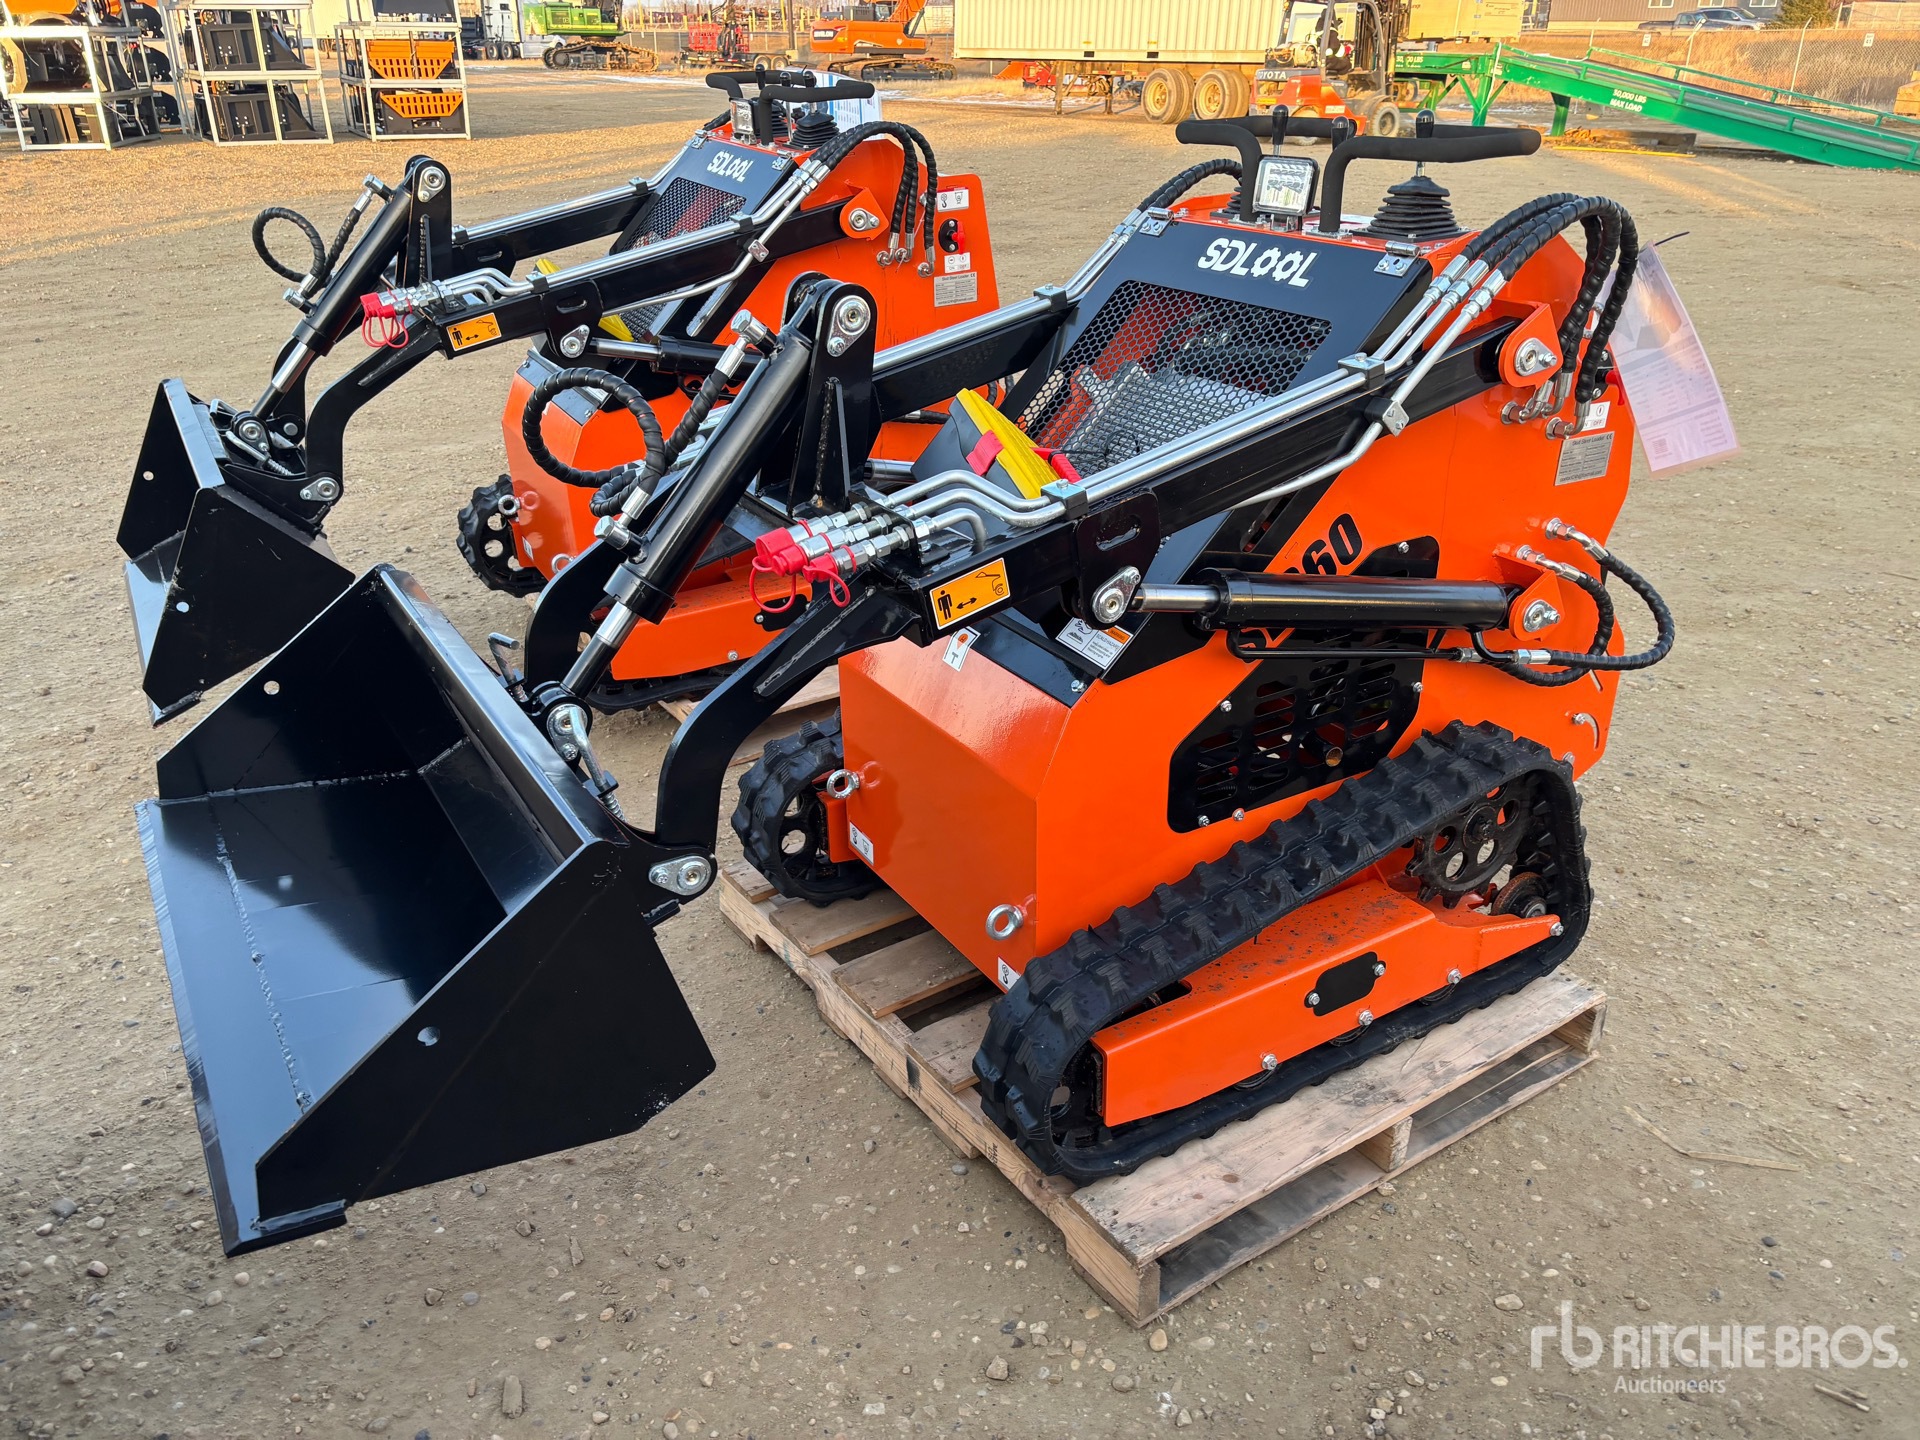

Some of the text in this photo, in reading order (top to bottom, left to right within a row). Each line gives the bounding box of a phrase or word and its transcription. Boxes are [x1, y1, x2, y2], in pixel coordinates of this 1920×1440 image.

[1610, 98, 1642, 112] MAX LOAD
[707, 151, 753, 182] SDLOOL
[1198, 238, 1317, 287] SDLOOL
[1284, 513, 1363, 576] 60
